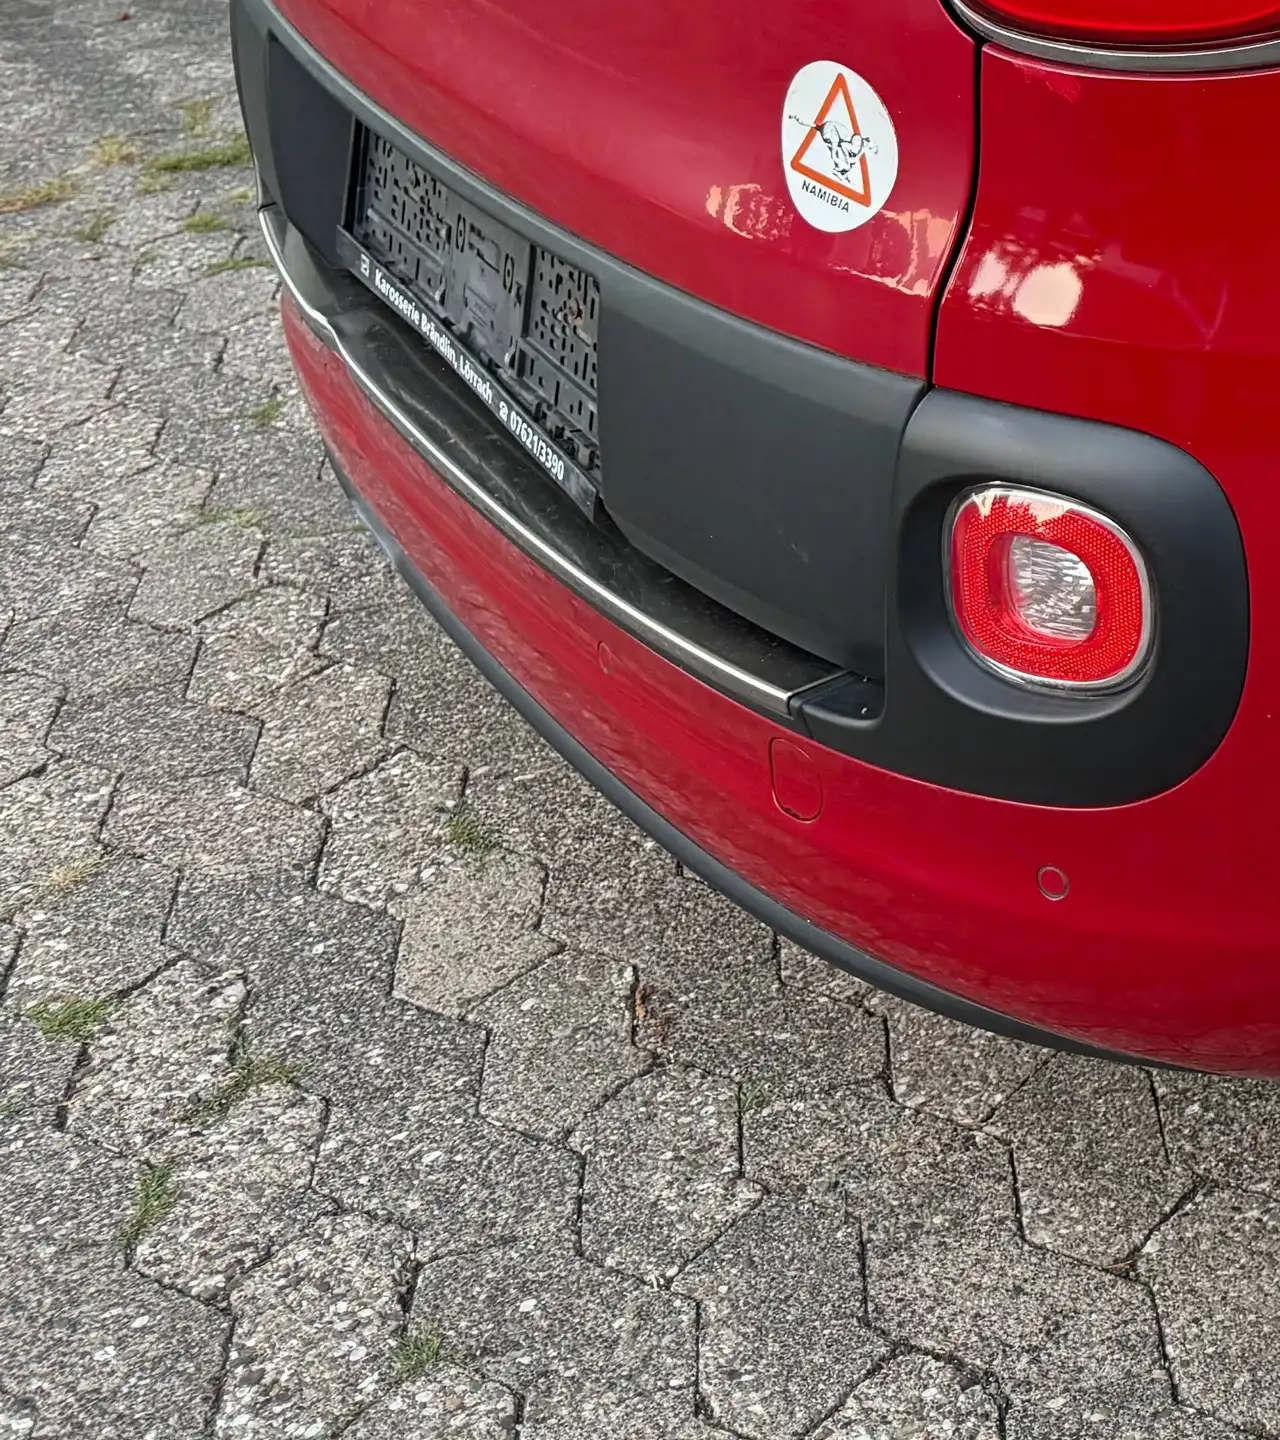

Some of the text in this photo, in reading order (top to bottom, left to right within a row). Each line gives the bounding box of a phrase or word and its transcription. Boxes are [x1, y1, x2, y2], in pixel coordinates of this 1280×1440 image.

[801, 179, 850, 214] NAMIBIA
[374, 268, 420, 325] Karosserie
[459, 354, 493, 405] Lörrach
[510, 411, 565, 481] 07621/3390
